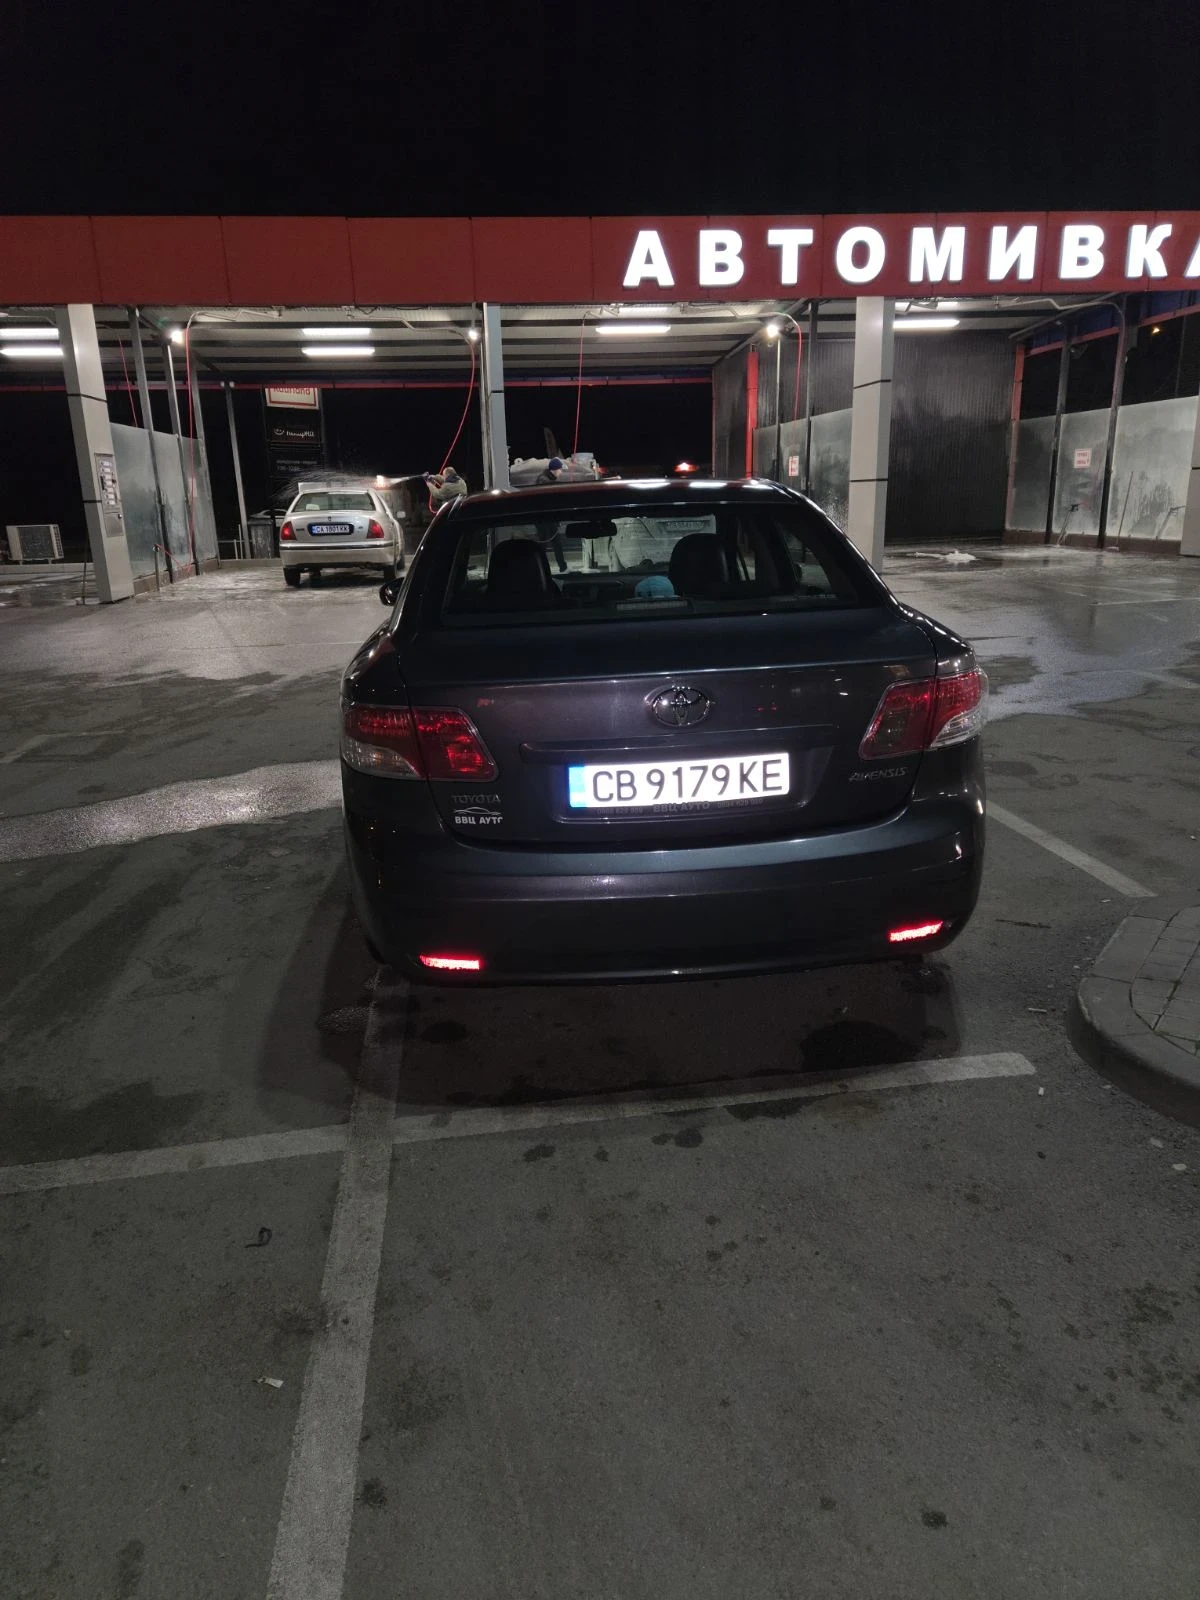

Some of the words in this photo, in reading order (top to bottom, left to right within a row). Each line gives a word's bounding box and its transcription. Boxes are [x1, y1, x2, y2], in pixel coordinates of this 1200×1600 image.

[592, 769, 637, 802] CB
[646, 764, 730, 800] 9179
[739, 759, 783, 793] KE
[451, 794, 501, 803] TOYOTA
[681, 801, 710, 811] АУТО
[454, 815, 476, 825] ВВЦ
